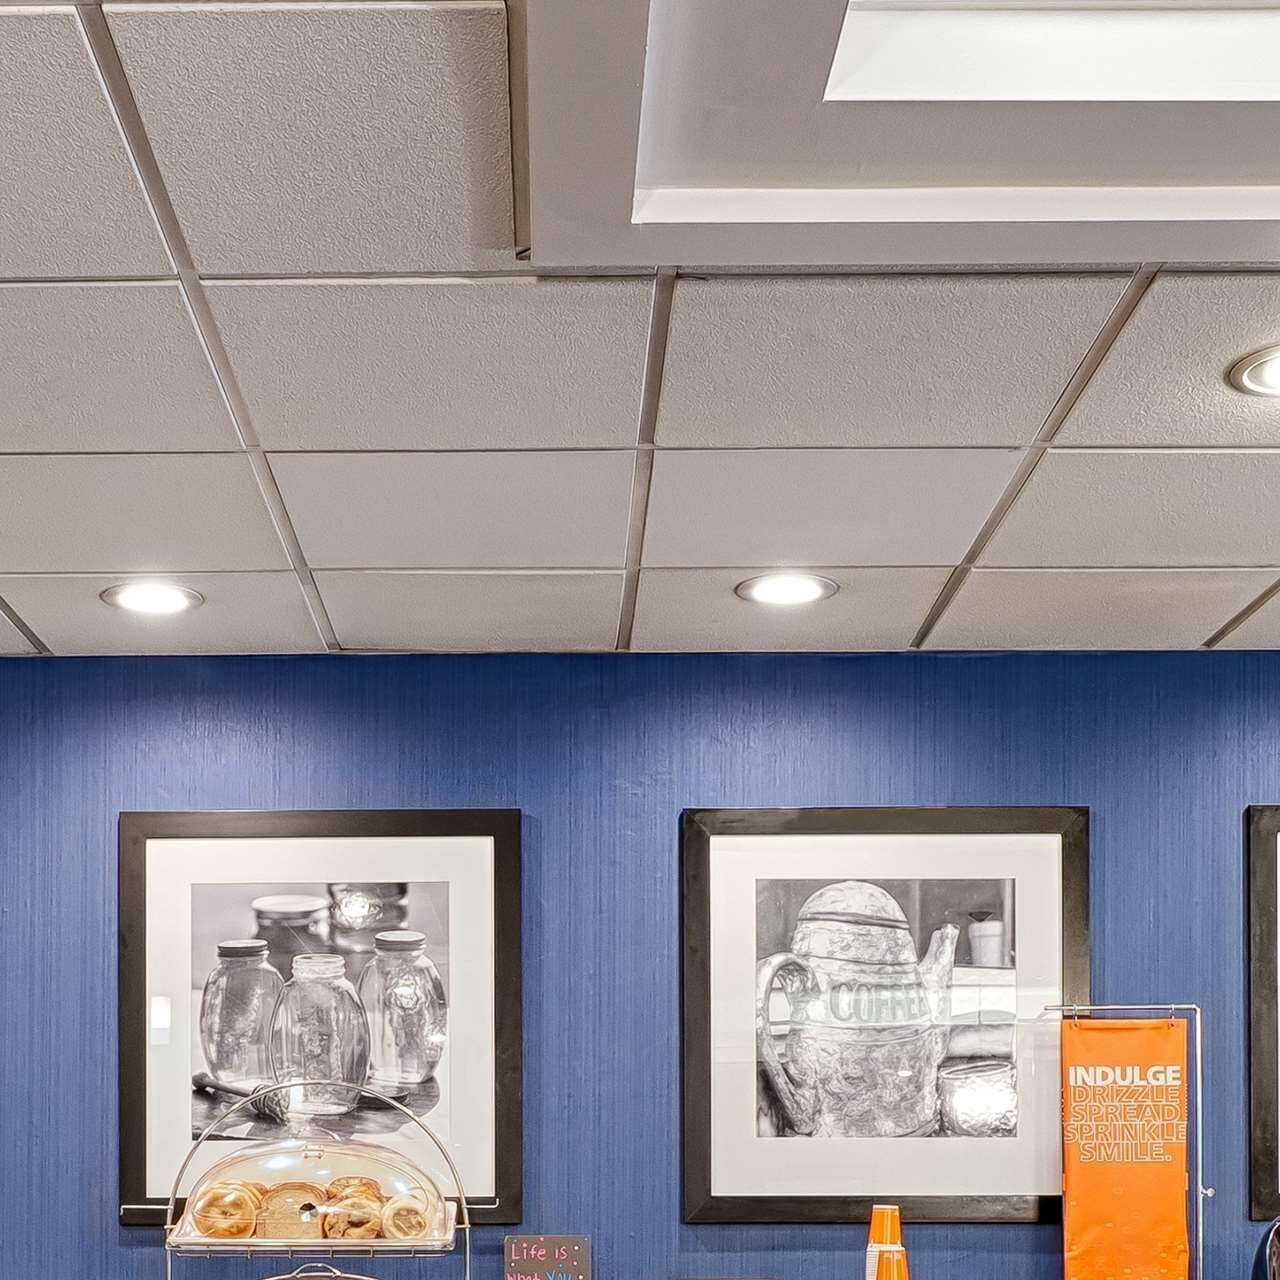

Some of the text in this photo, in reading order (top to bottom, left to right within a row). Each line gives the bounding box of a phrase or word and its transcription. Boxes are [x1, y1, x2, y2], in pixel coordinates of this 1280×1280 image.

[1068, 1065, 1182, 1087] INDULGE
[1071, 1083, 1181, 1105] DRIZZLE
[1070, 1102, 1182, 1124] SPREAD
[1063, 1120, 1187, 1143] SPRINKLE
[1079, 1141, 1174, 1163] SMILE.
[510, 1242, 547, 1261] Life
